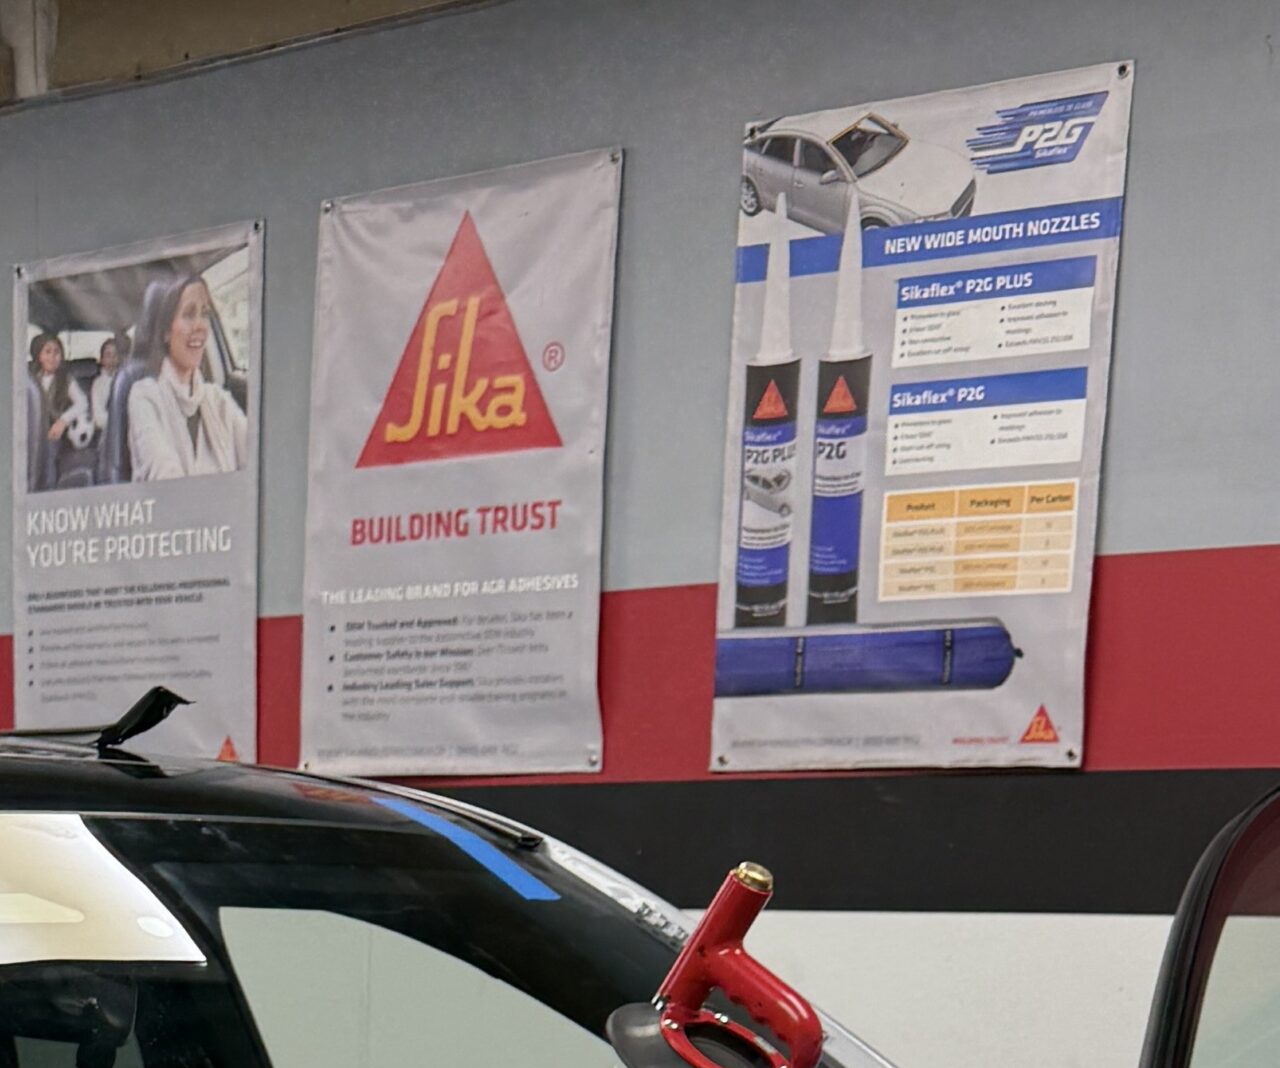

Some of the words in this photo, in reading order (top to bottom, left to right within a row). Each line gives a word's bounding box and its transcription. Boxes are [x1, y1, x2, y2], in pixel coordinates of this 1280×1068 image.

[1008, 116, 1098, 151] P2G
[884, 236, 922, 255] NEW
[924, 230, 964, 250] WIDE
[968, 222, 1023, 244] MOUTH
[1026, 212, 1101, 236] NOZZLES
[966, 277, 993, 294] P2G
[996, 272, 1033, 290] PLUS
[383, 296, 528, 444] Sika
[957, 385, 985, 402] P2G
[27, 505, 90, 537] KNOW
[94, 499, 157, 530] WHAT
[350, 508, 470, 546] BUILDING
[476, 500, 563, 536] TRUST
[27, 536, 100, 568] YOU'RE
[104, 525, 232, 562] PROTECTING
[321, 590, 346, 605] THE
[348, 586, 404, 604] LEADING
[405, 583, 451, 600] BRAND
[452, 581, 479, 598] FOR
[507, 573, 580, 593] ADHESIVES
